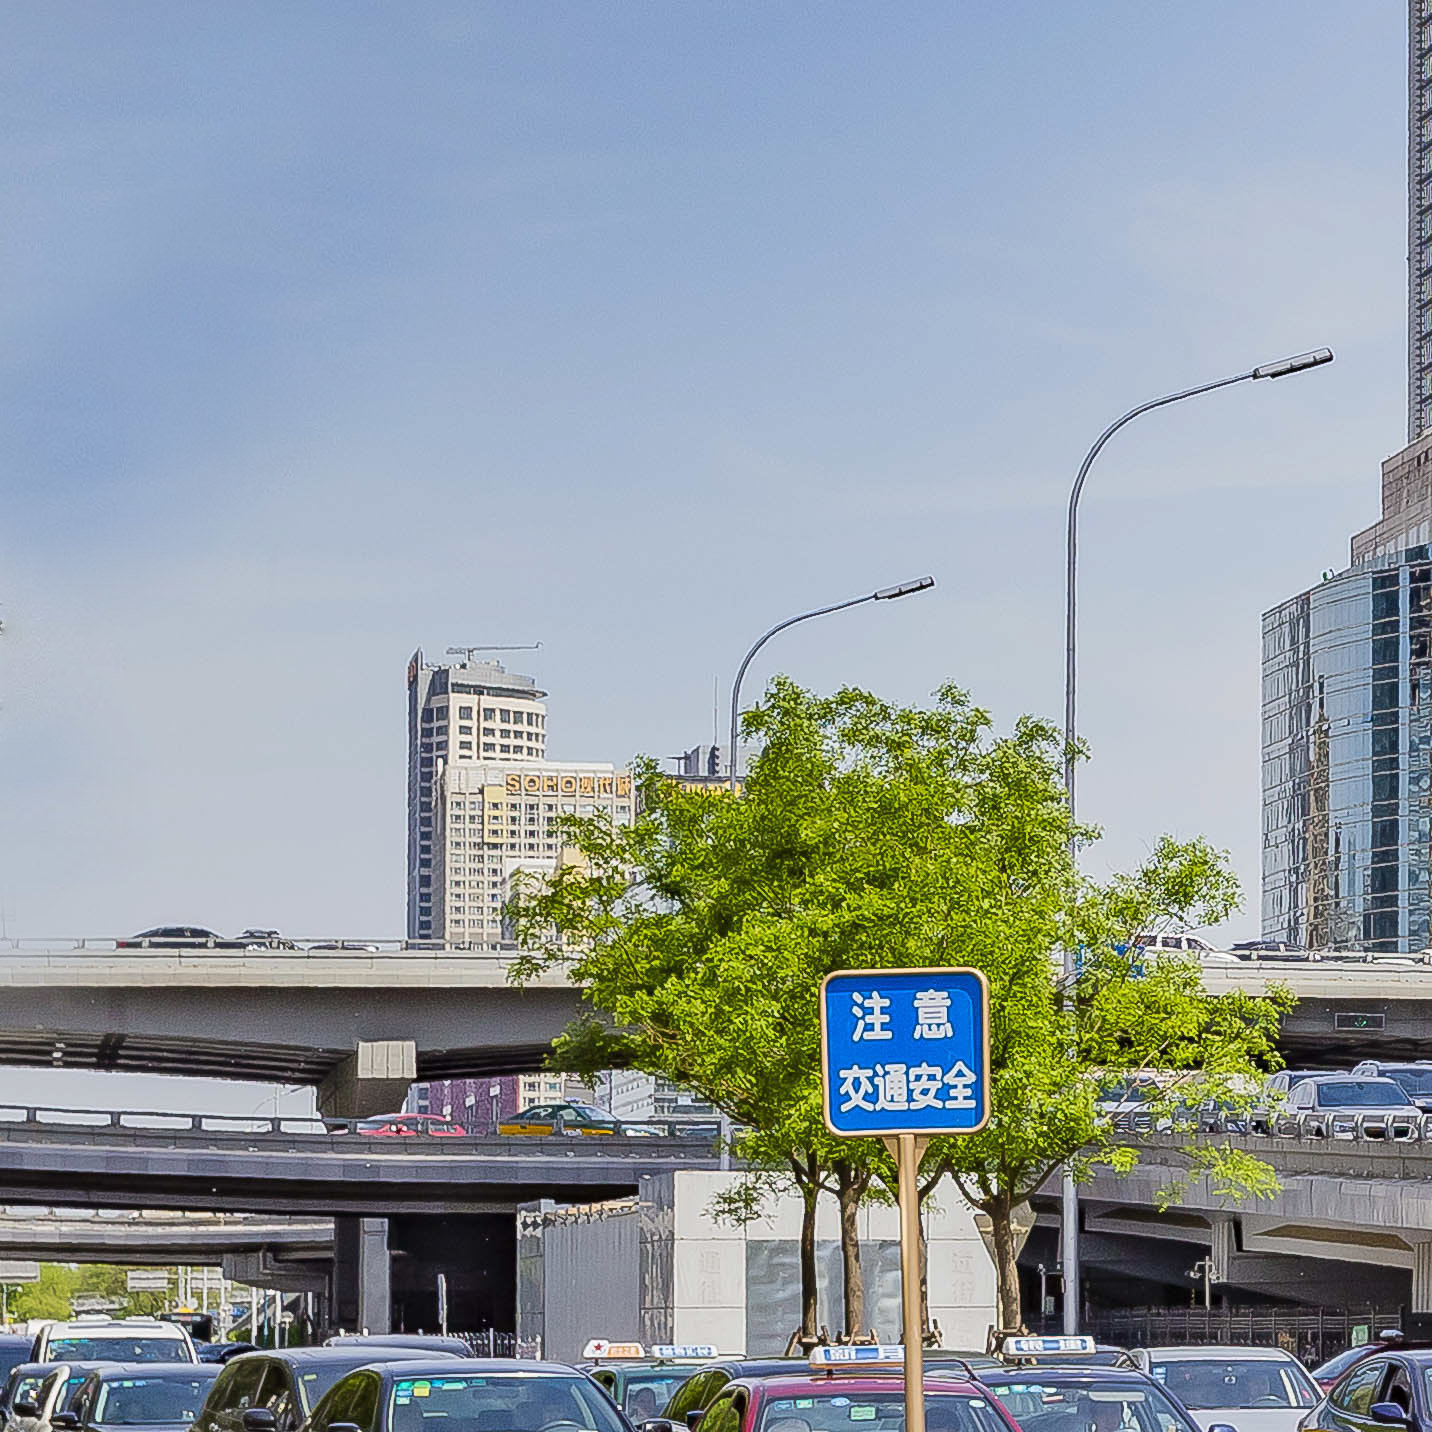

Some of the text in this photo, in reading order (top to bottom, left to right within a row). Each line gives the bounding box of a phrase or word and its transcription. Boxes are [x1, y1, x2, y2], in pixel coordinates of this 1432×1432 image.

[851, 988, 954, 1043] 注意
[839, 1060, 977, 1113] 交通安全
